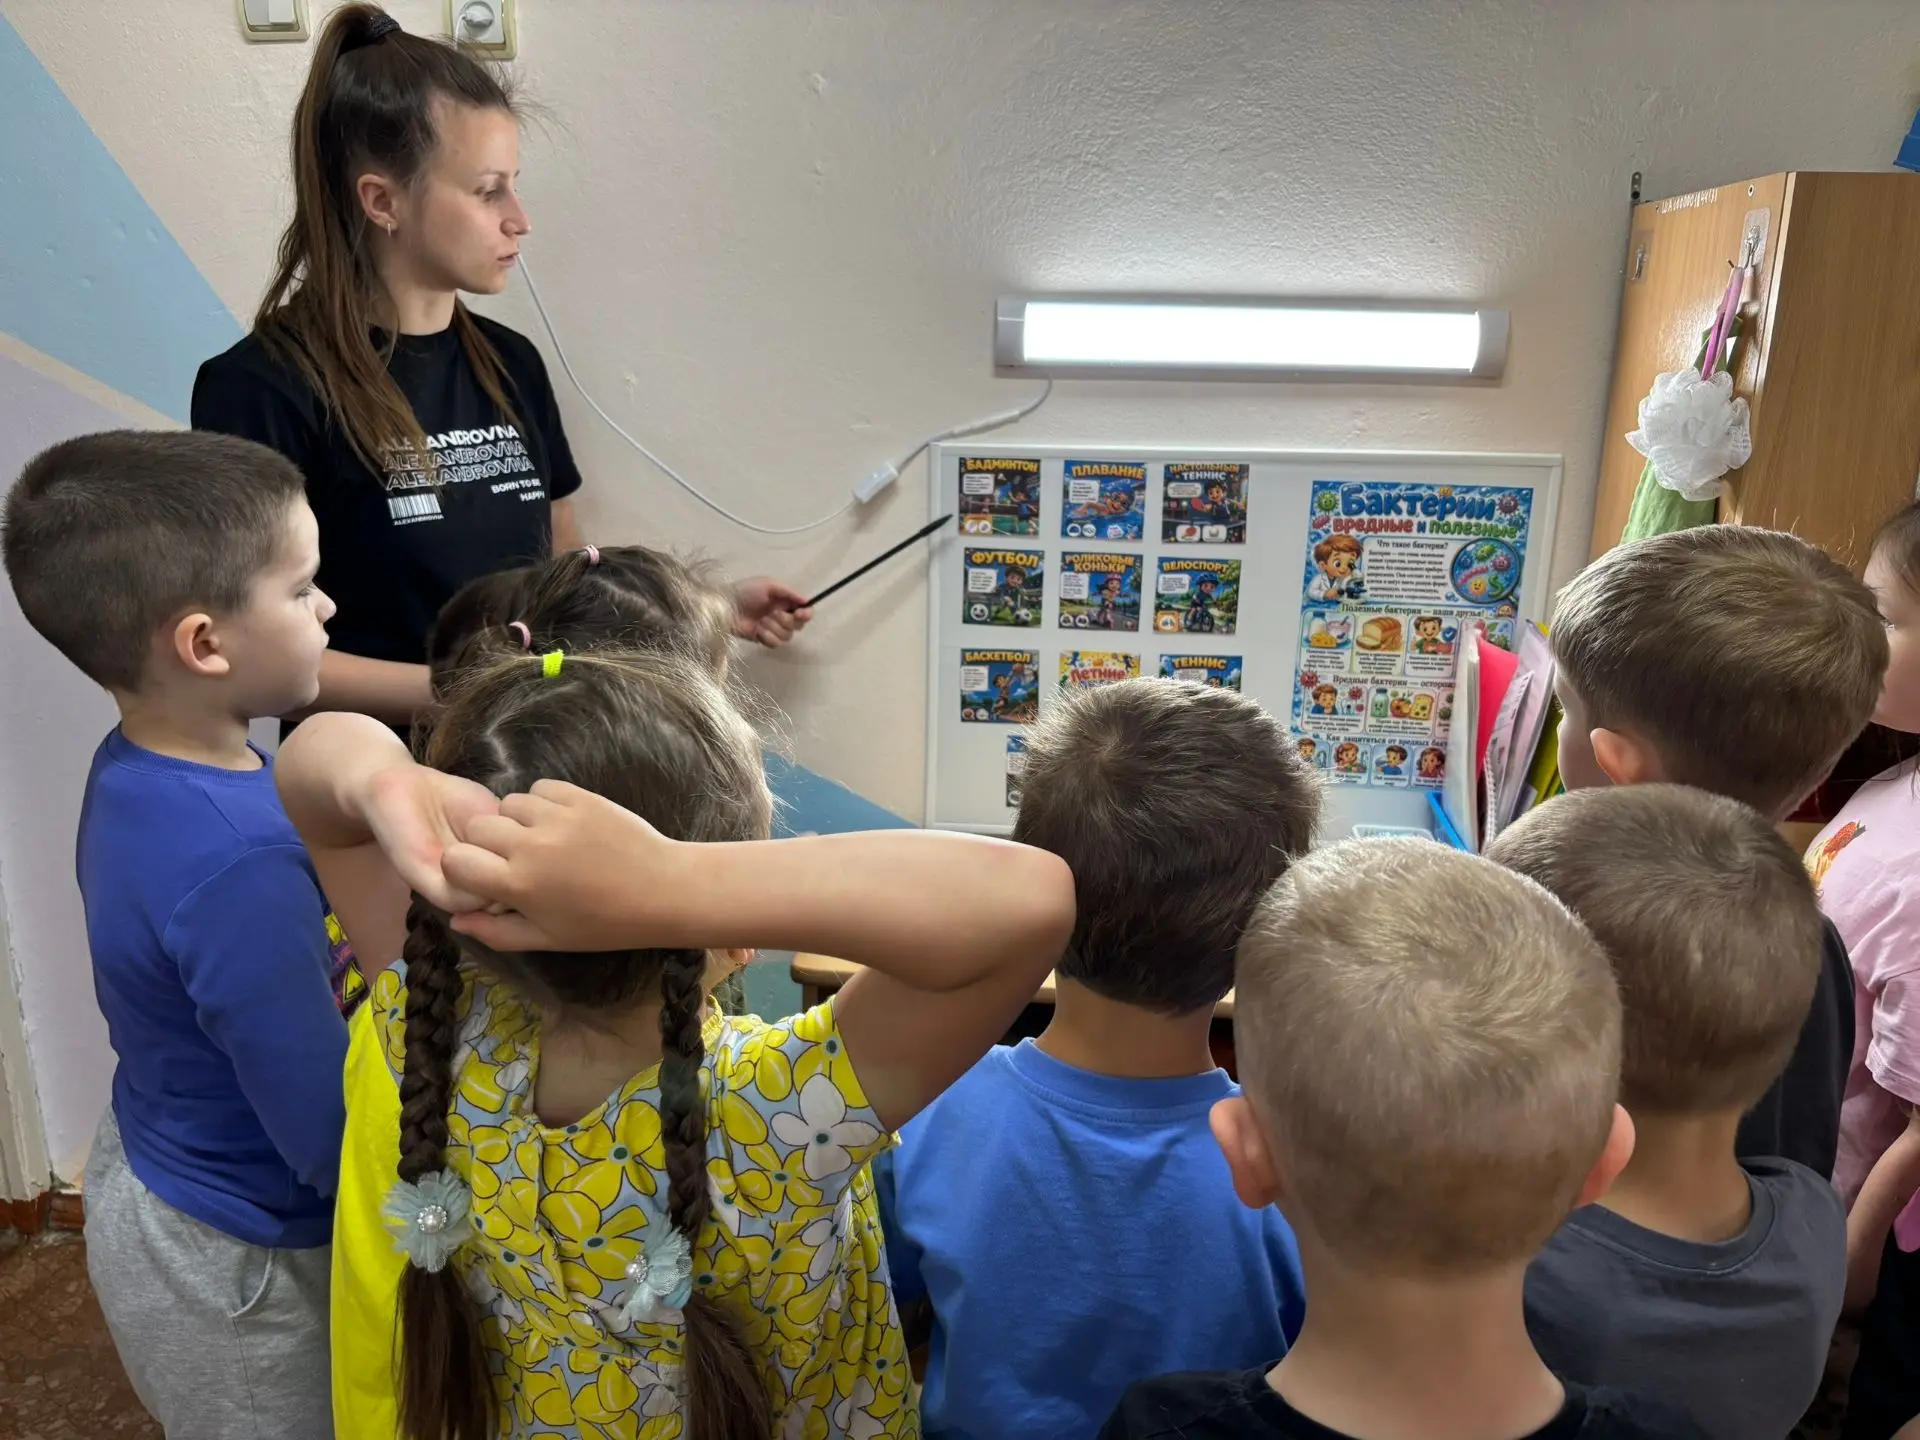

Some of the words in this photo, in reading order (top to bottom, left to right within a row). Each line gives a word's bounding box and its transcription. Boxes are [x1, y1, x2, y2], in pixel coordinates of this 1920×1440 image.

[966, 459, 1038, 472] БАДМИНТОН
[1071, 464, 1145, 479] ПЛАВАНИЕ
[1182, 471, 1227, 480] ТЕННИС
[491, 481, 520, 494] BORN
[519, 479, 531, 488] TO
[1340, 484, 1496, 521] Бактерии
[1333, 518, 1413, 534] вредные
[1416, 520, 1426, 533] и
[1429, 520, 1516, 538] полезные
[1377, 539, 1390, 549] Что
[1391, 541, 1411, 549] такое
[972, 551, 1038, 567] ФУТБОЛ
[1065, 554, 1134, 566] РОЛИКОВЫЕ
[1074, 562, 1125, 573] КОНЬКИ
[1162, 560, 1229, 572] ВЕЛОСПОРТ
[1342, 604, 1382, 613] Полезные
[1384, 605, 1422, 616] бактерии
[1455, 609, 1484, 618] друзья!
[964, 651, 1031, 663] БАСКЕТБОЛ
[1171, 657, 1228, 669] ТЕННИС
[1070, 668, 1126, 683] Летние
[1333, 675, 1368, 686] Вредные
[1370, 676, 1407, 687] бактерии
[1420, 680, 1456, 690] осторож
